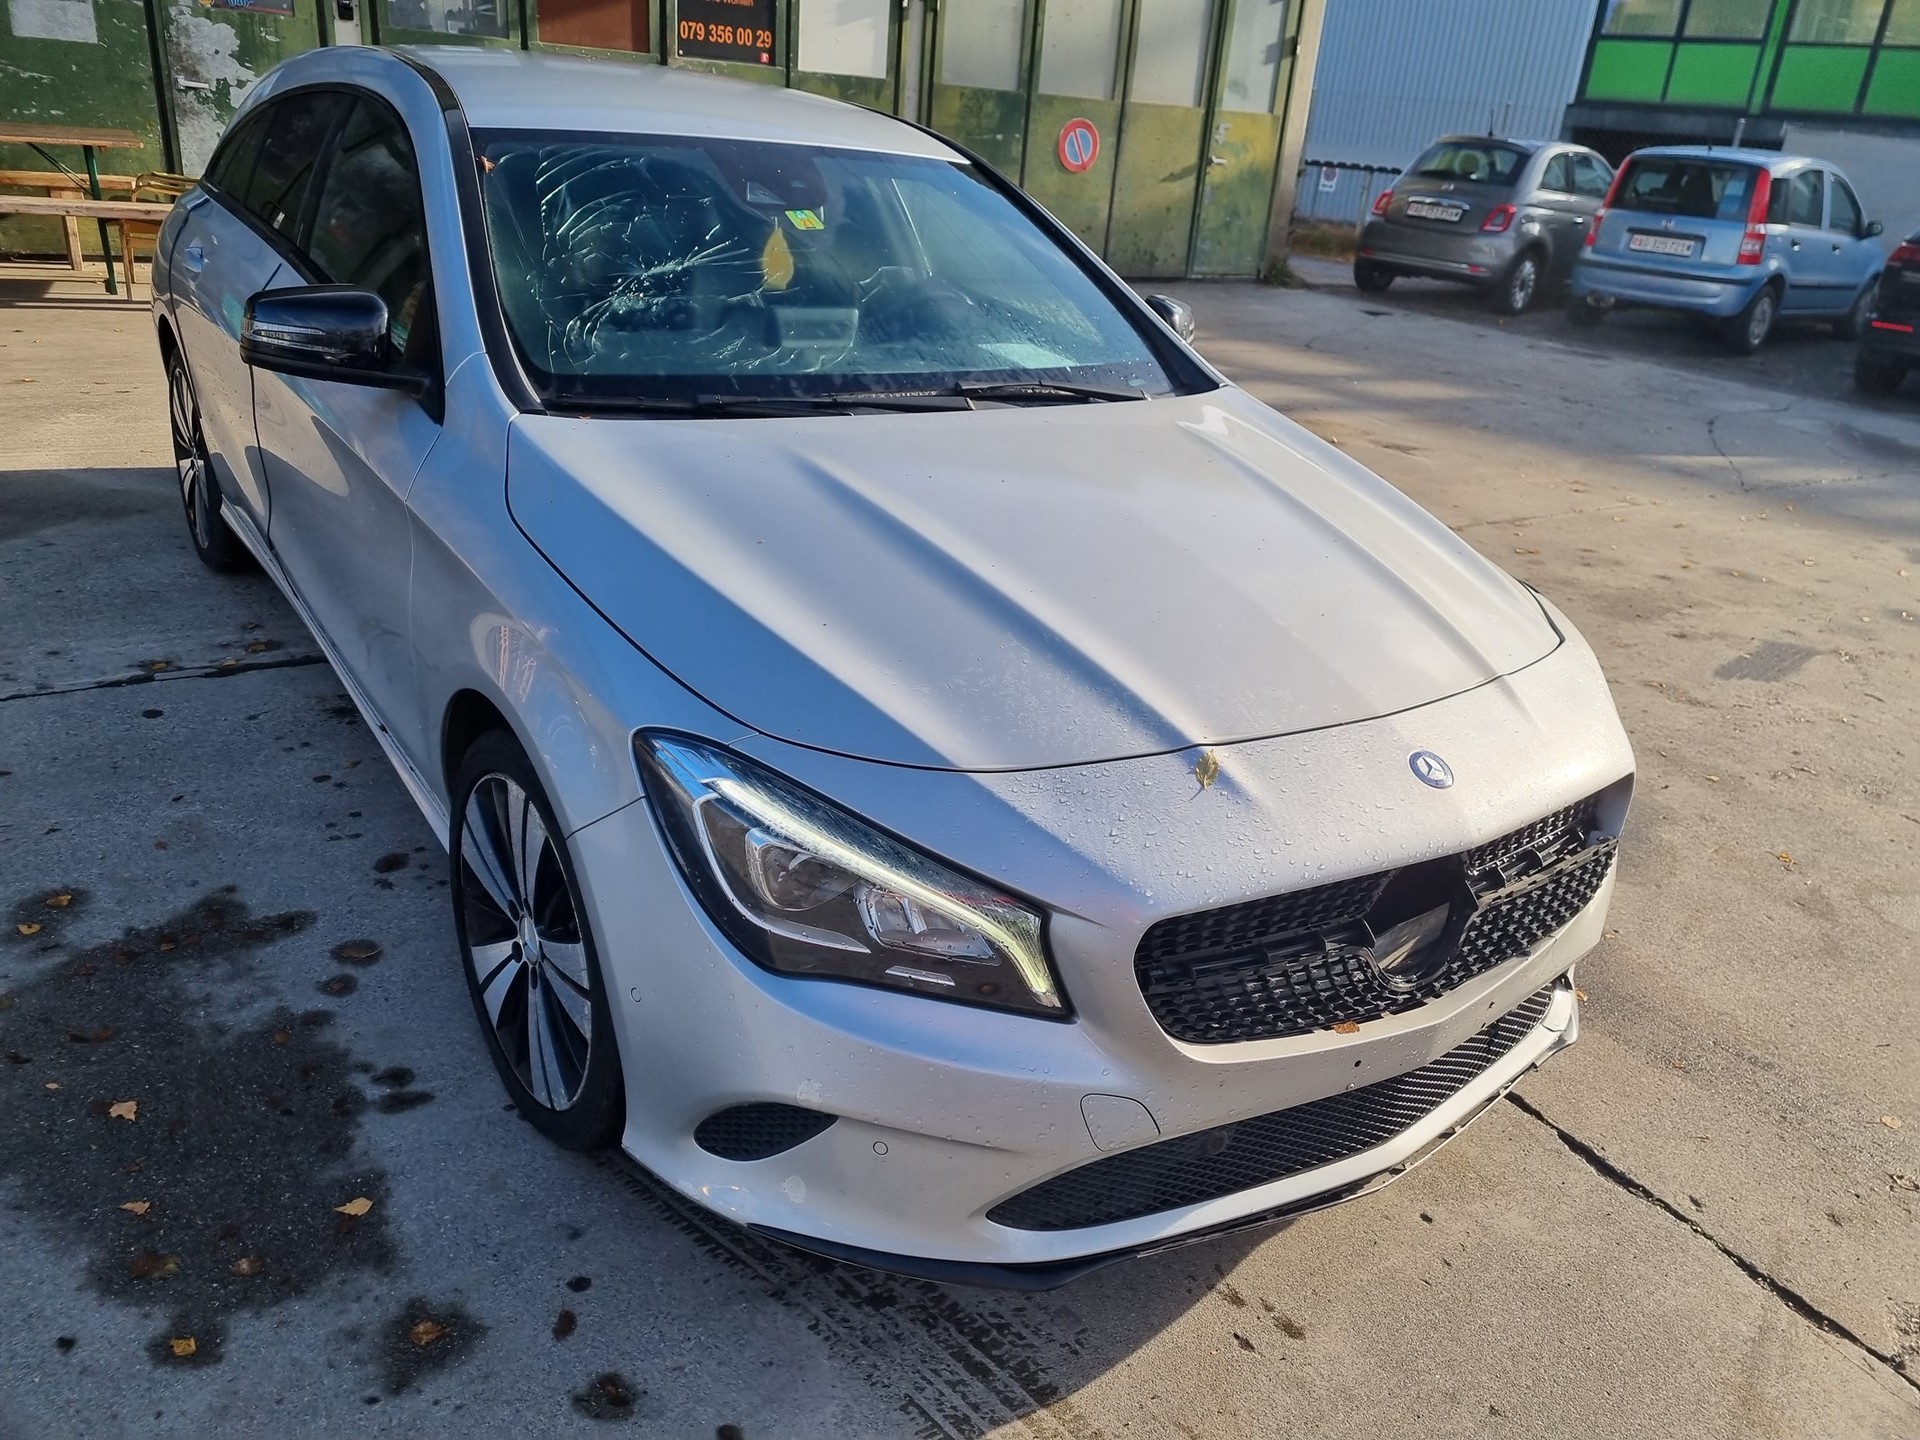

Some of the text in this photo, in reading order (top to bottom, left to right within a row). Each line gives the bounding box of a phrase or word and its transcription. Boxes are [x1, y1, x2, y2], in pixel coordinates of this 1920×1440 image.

[680, 20, 772, 48] 079 356 00 29
